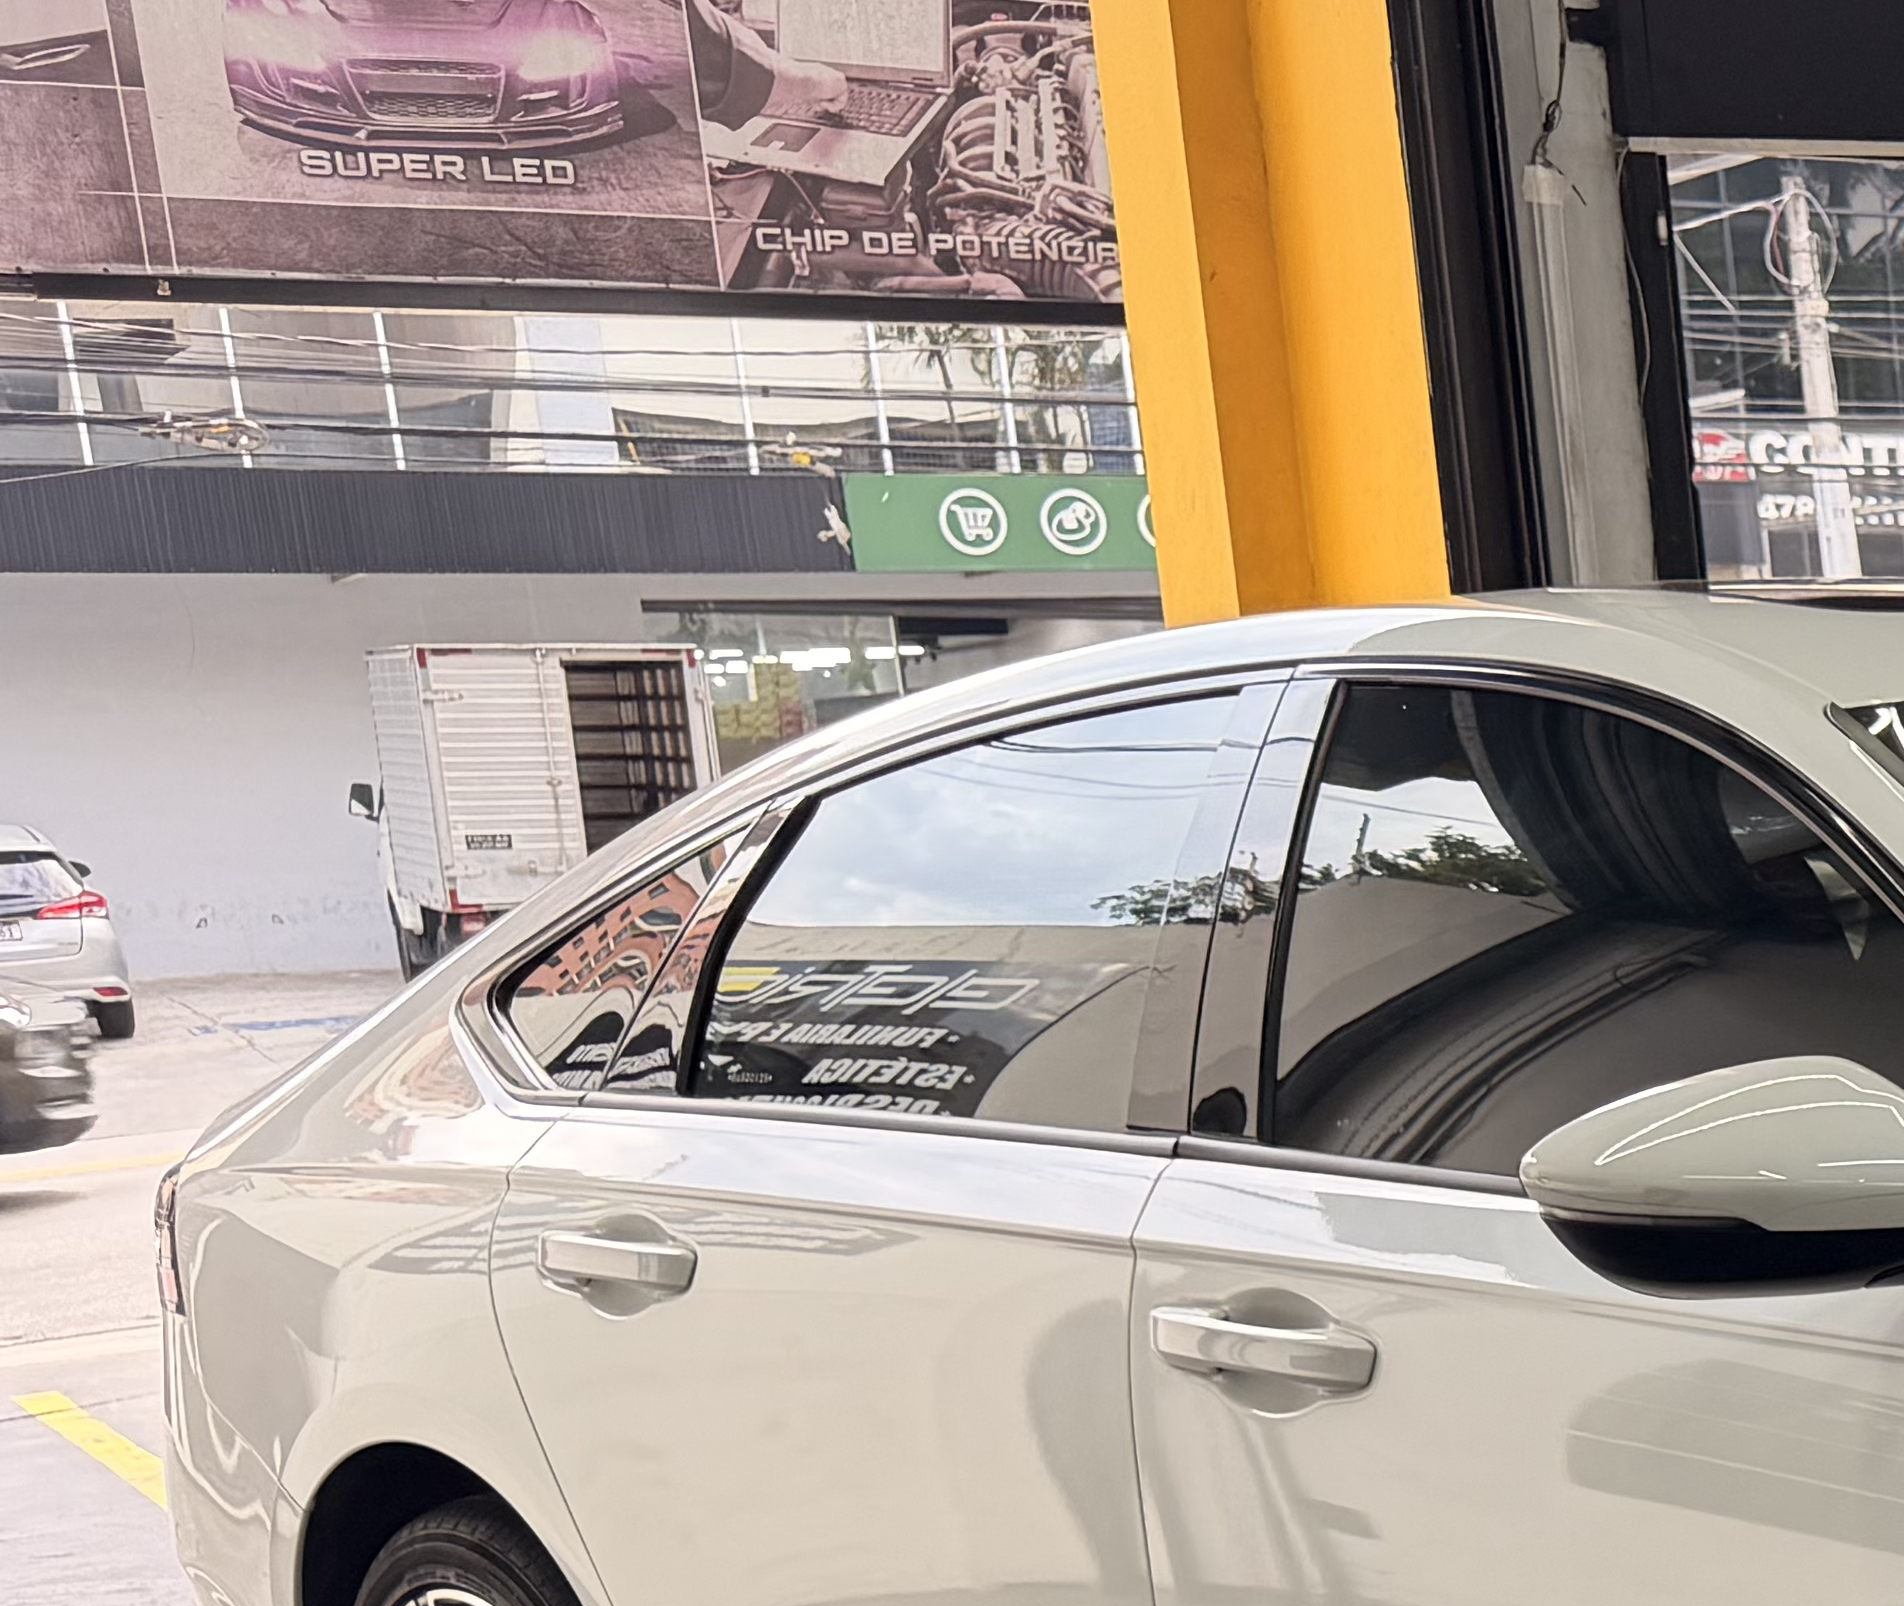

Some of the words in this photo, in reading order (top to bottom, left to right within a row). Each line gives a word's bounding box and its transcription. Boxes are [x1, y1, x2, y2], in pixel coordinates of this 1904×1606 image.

[299, 148, 467, 181] SUPER
[481, 156, 576, 185] LED
[755, 227, 850, 253] CHIP
[863, 230, 917, 255] DE
[928, 229, 1119, 264] POTÊNCIA
